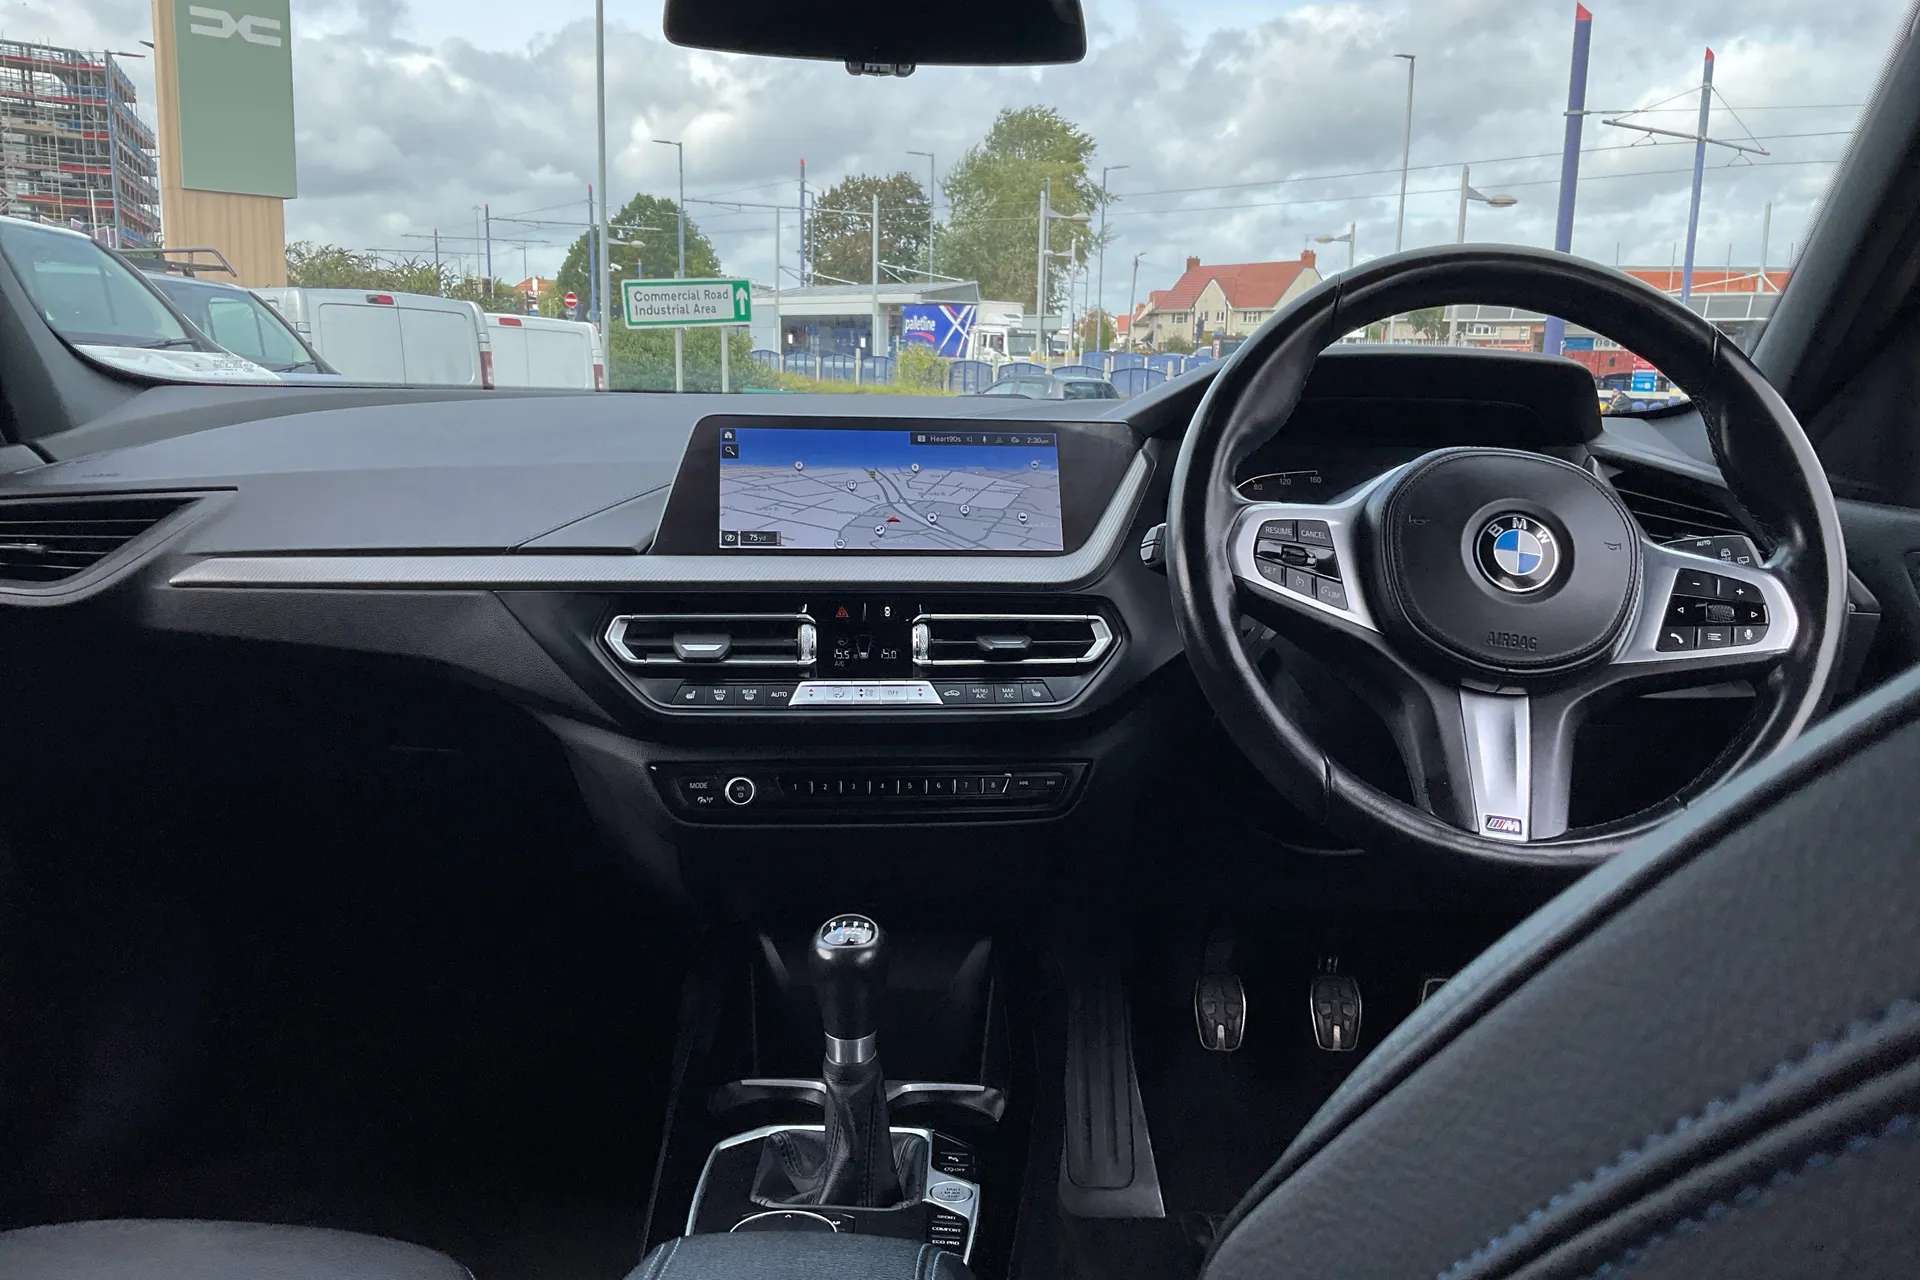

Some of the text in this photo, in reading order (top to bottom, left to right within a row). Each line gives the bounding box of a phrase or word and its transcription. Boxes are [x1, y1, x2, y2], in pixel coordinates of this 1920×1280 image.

[633, 289, 729, 303] Commercial Road
[634, 303, 717, 316] Industrial Area
[1280, 478, 1292, 486] 120
[1309, 476, 1322, 484] 160
[1265, 526, 1293, 536] RESUME
[1300, 529, 1326, 539] CANCEL
[1488, 517, 1551, 545] BMW
[749, 534, 758, 542] 75
[1263, 566, 1276, 574] SET
[1487, 631, 1537, 651] AIRBAG
